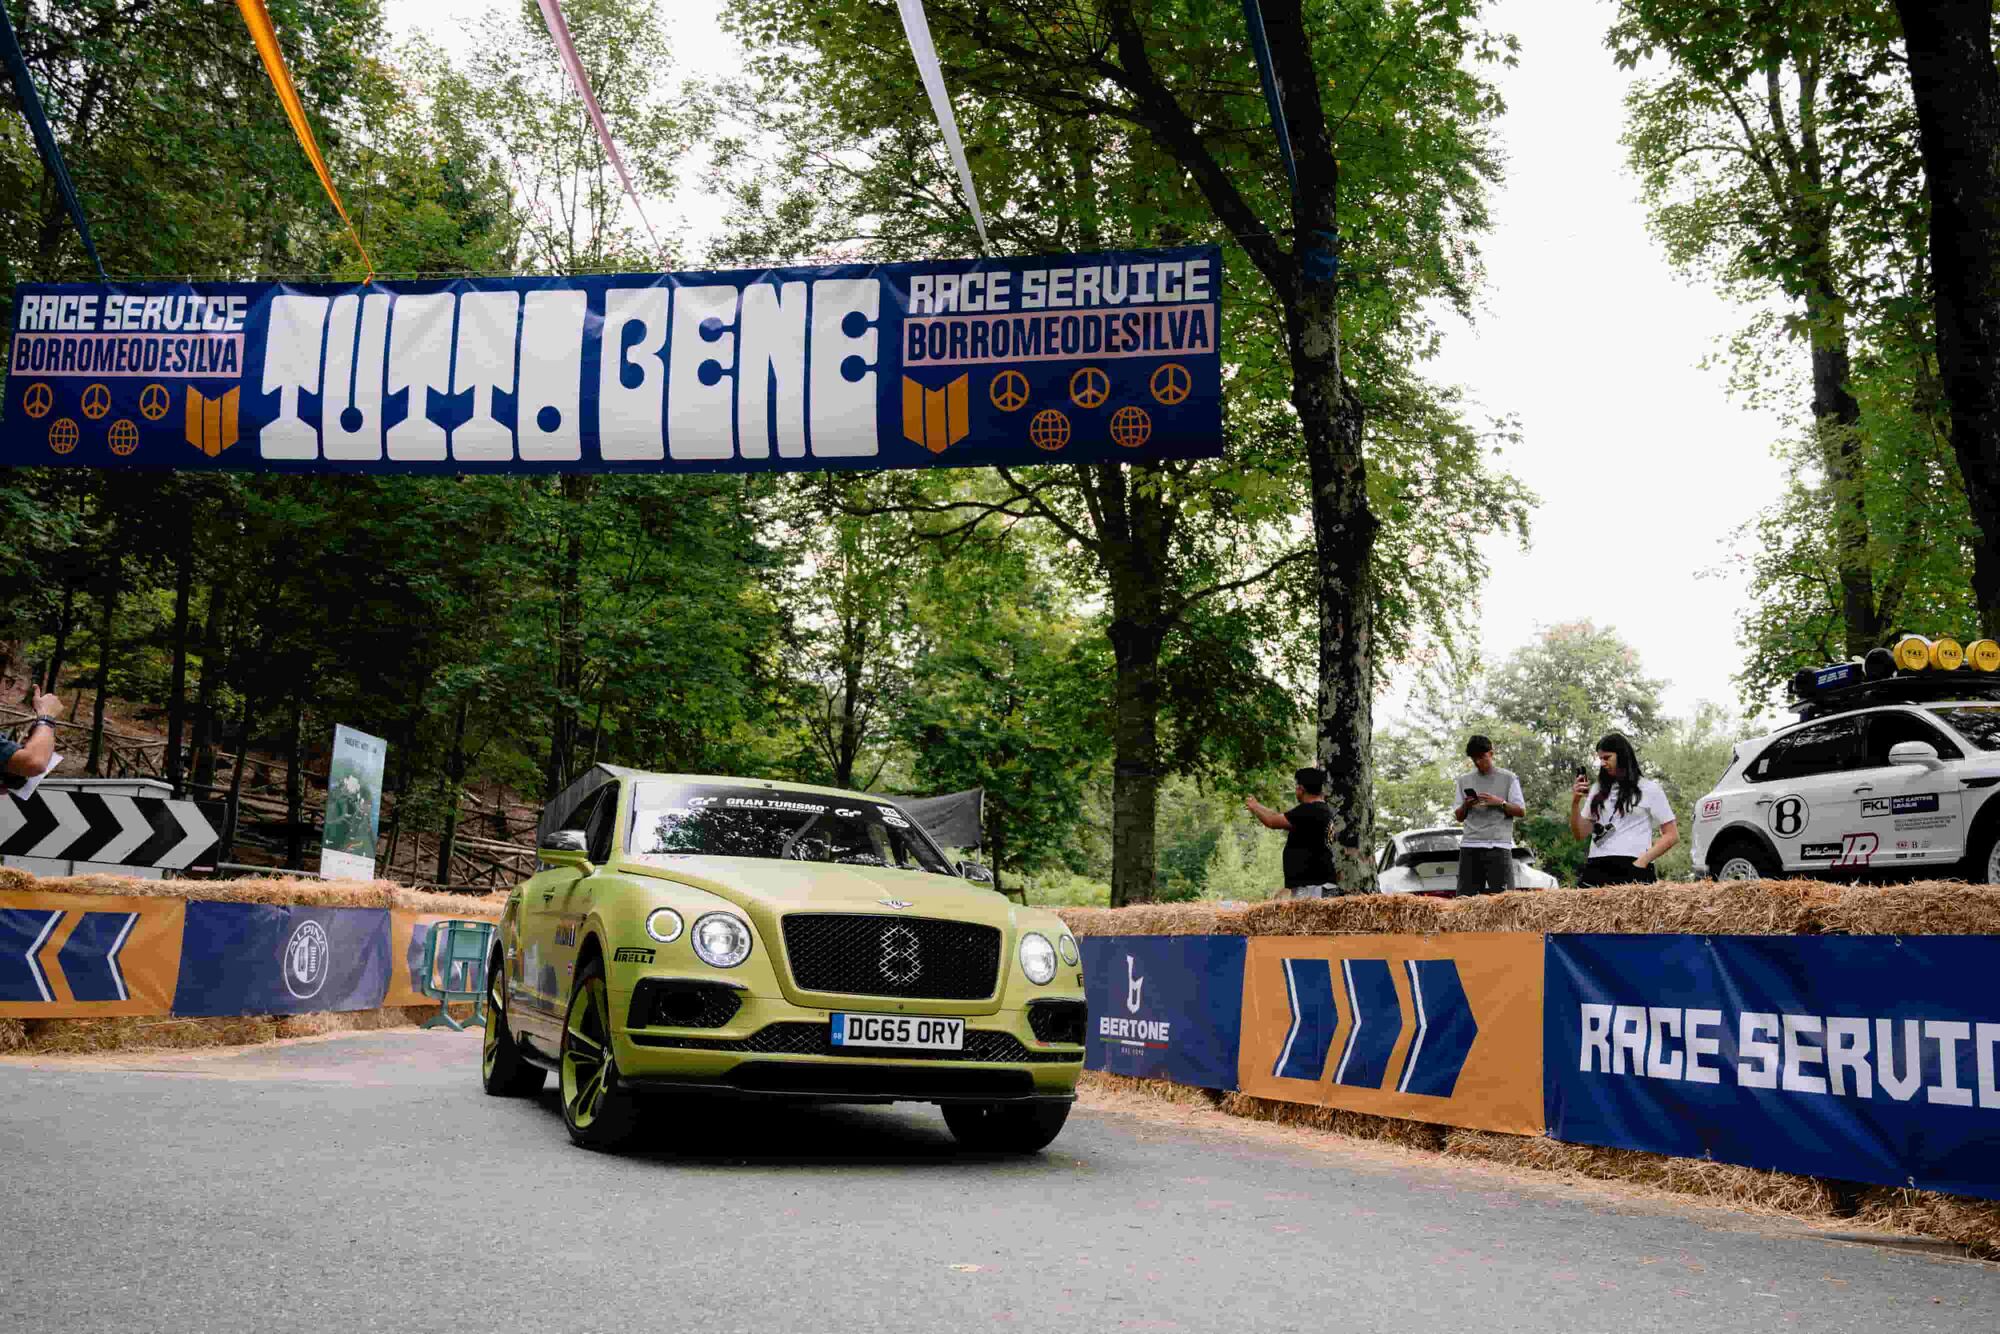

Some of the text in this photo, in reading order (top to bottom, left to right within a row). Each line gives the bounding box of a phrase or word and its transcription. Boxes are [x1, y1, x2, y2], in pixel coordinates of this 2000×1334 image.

[908, 249, 1210, 315] RACE SERVICE
[19, 295, 248, 331] RACE SERVICE
[907, 308, 1210, 362] BORROMEODESILVA
[15, 337, 239, 373] BORROMEODESILVA
[598, 278, 881, 461] BENE
[726, 797, 764, 808] GRAN
[767, 800, 826, 813] TURISMO
[1863, 800, 1889, 812] FKL
[289, 925, 326, 957] ALPINA
[613, 946, 656, 965] PIRELLI
[848, 1017, 960, 1045] DG65 ORY
[1099, 1016, 1170, 1042] BERTONE
[1579, 1003, 1722, 1085] RACE
